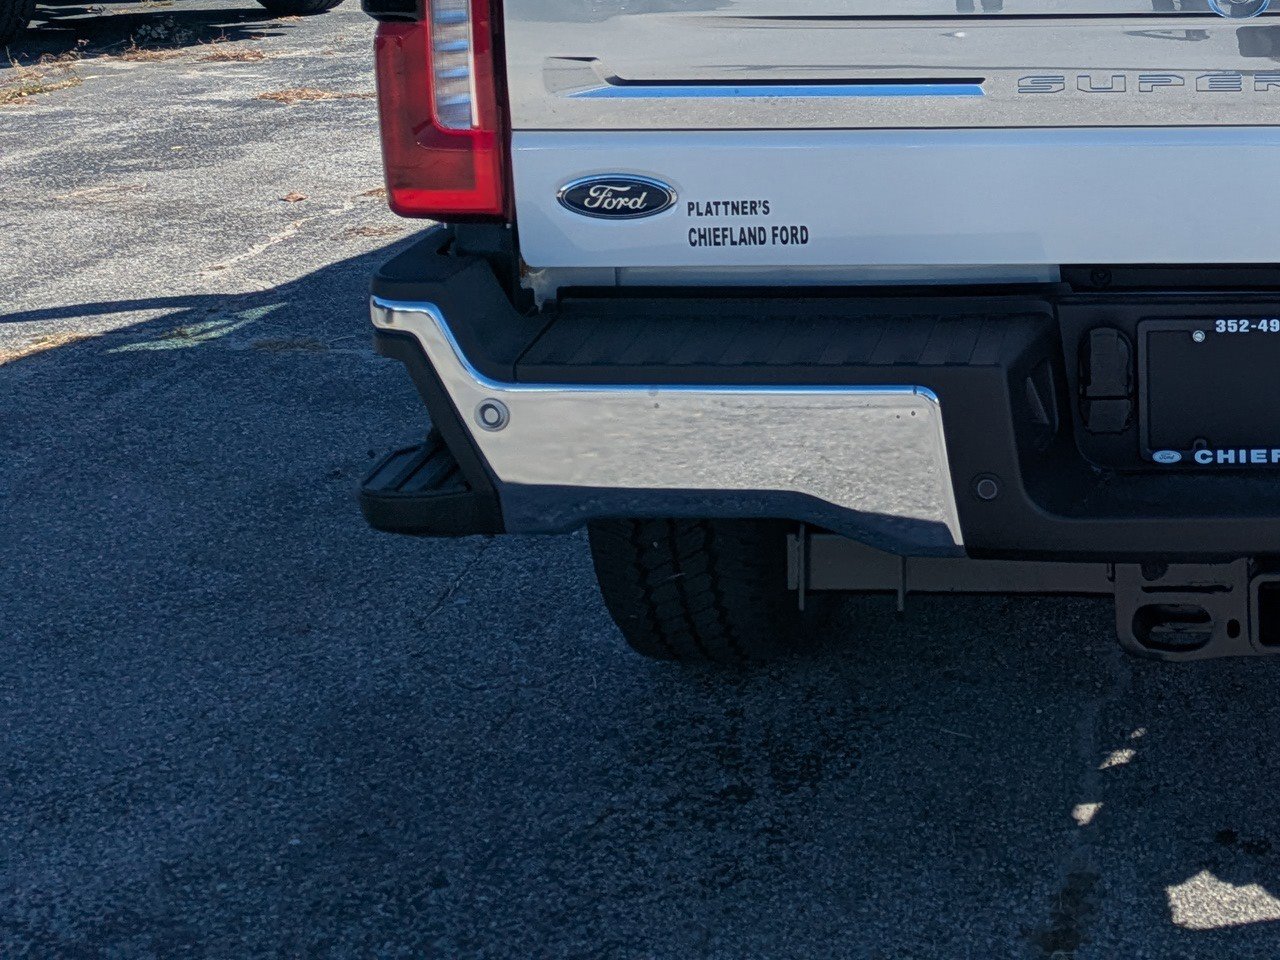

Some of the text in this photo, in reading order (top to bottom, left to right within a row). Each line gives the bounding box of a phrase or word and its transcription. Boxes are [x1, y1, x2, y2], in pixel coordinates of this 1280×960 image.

[583, 184, 647, 210] Ford
[687, 200, 770, 217] PLATTNER'S
[688, 225, 809, 247] CHIEFLAND FORD
